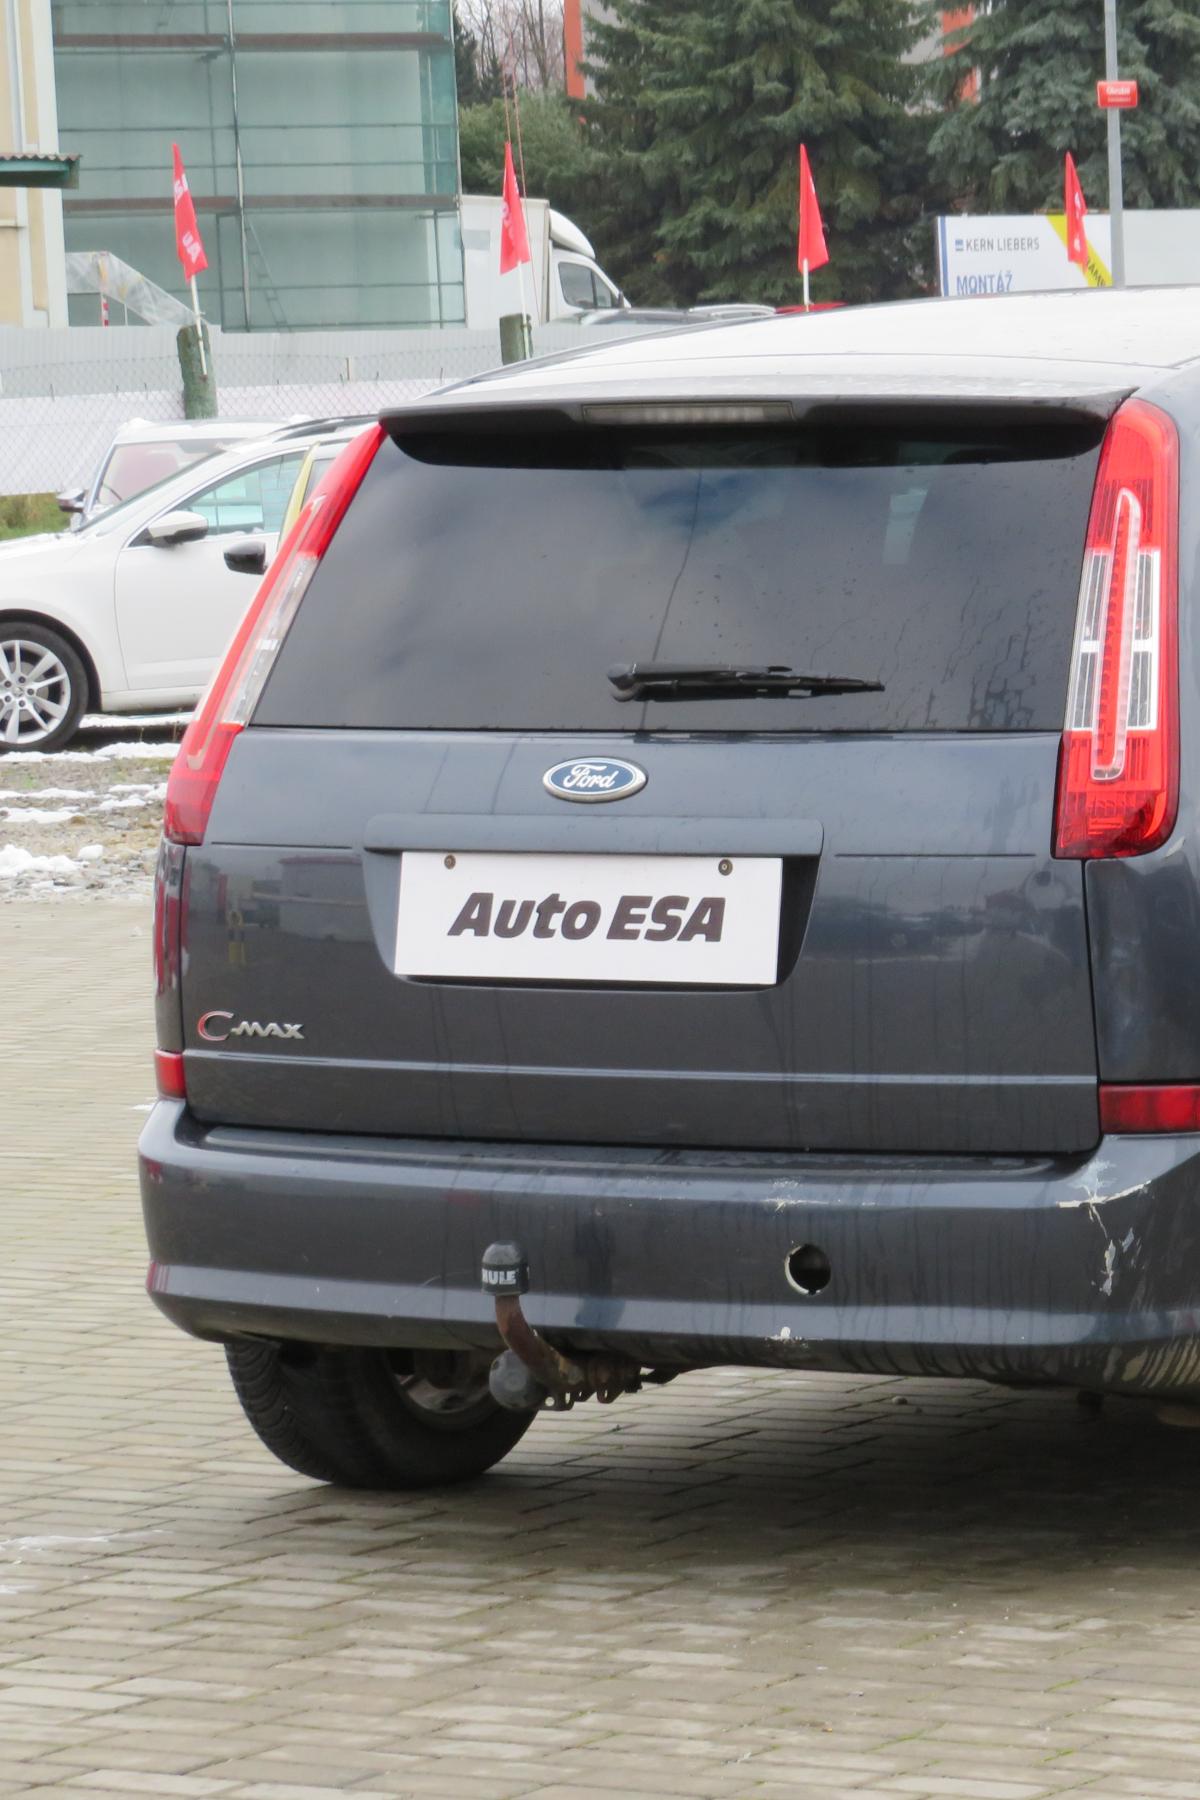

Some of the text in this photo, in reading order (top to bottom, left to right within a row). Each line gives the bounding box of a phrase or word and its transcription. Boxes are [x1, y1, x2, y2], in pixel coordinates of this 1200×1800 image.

[966, 237, 1040, 252] KERN LIEBERS
[956, 270, 1013, 295] MONTÁŽ
[563, 764, 618, 788] Ford
[448, 893, 726, 942] Auto ESA
